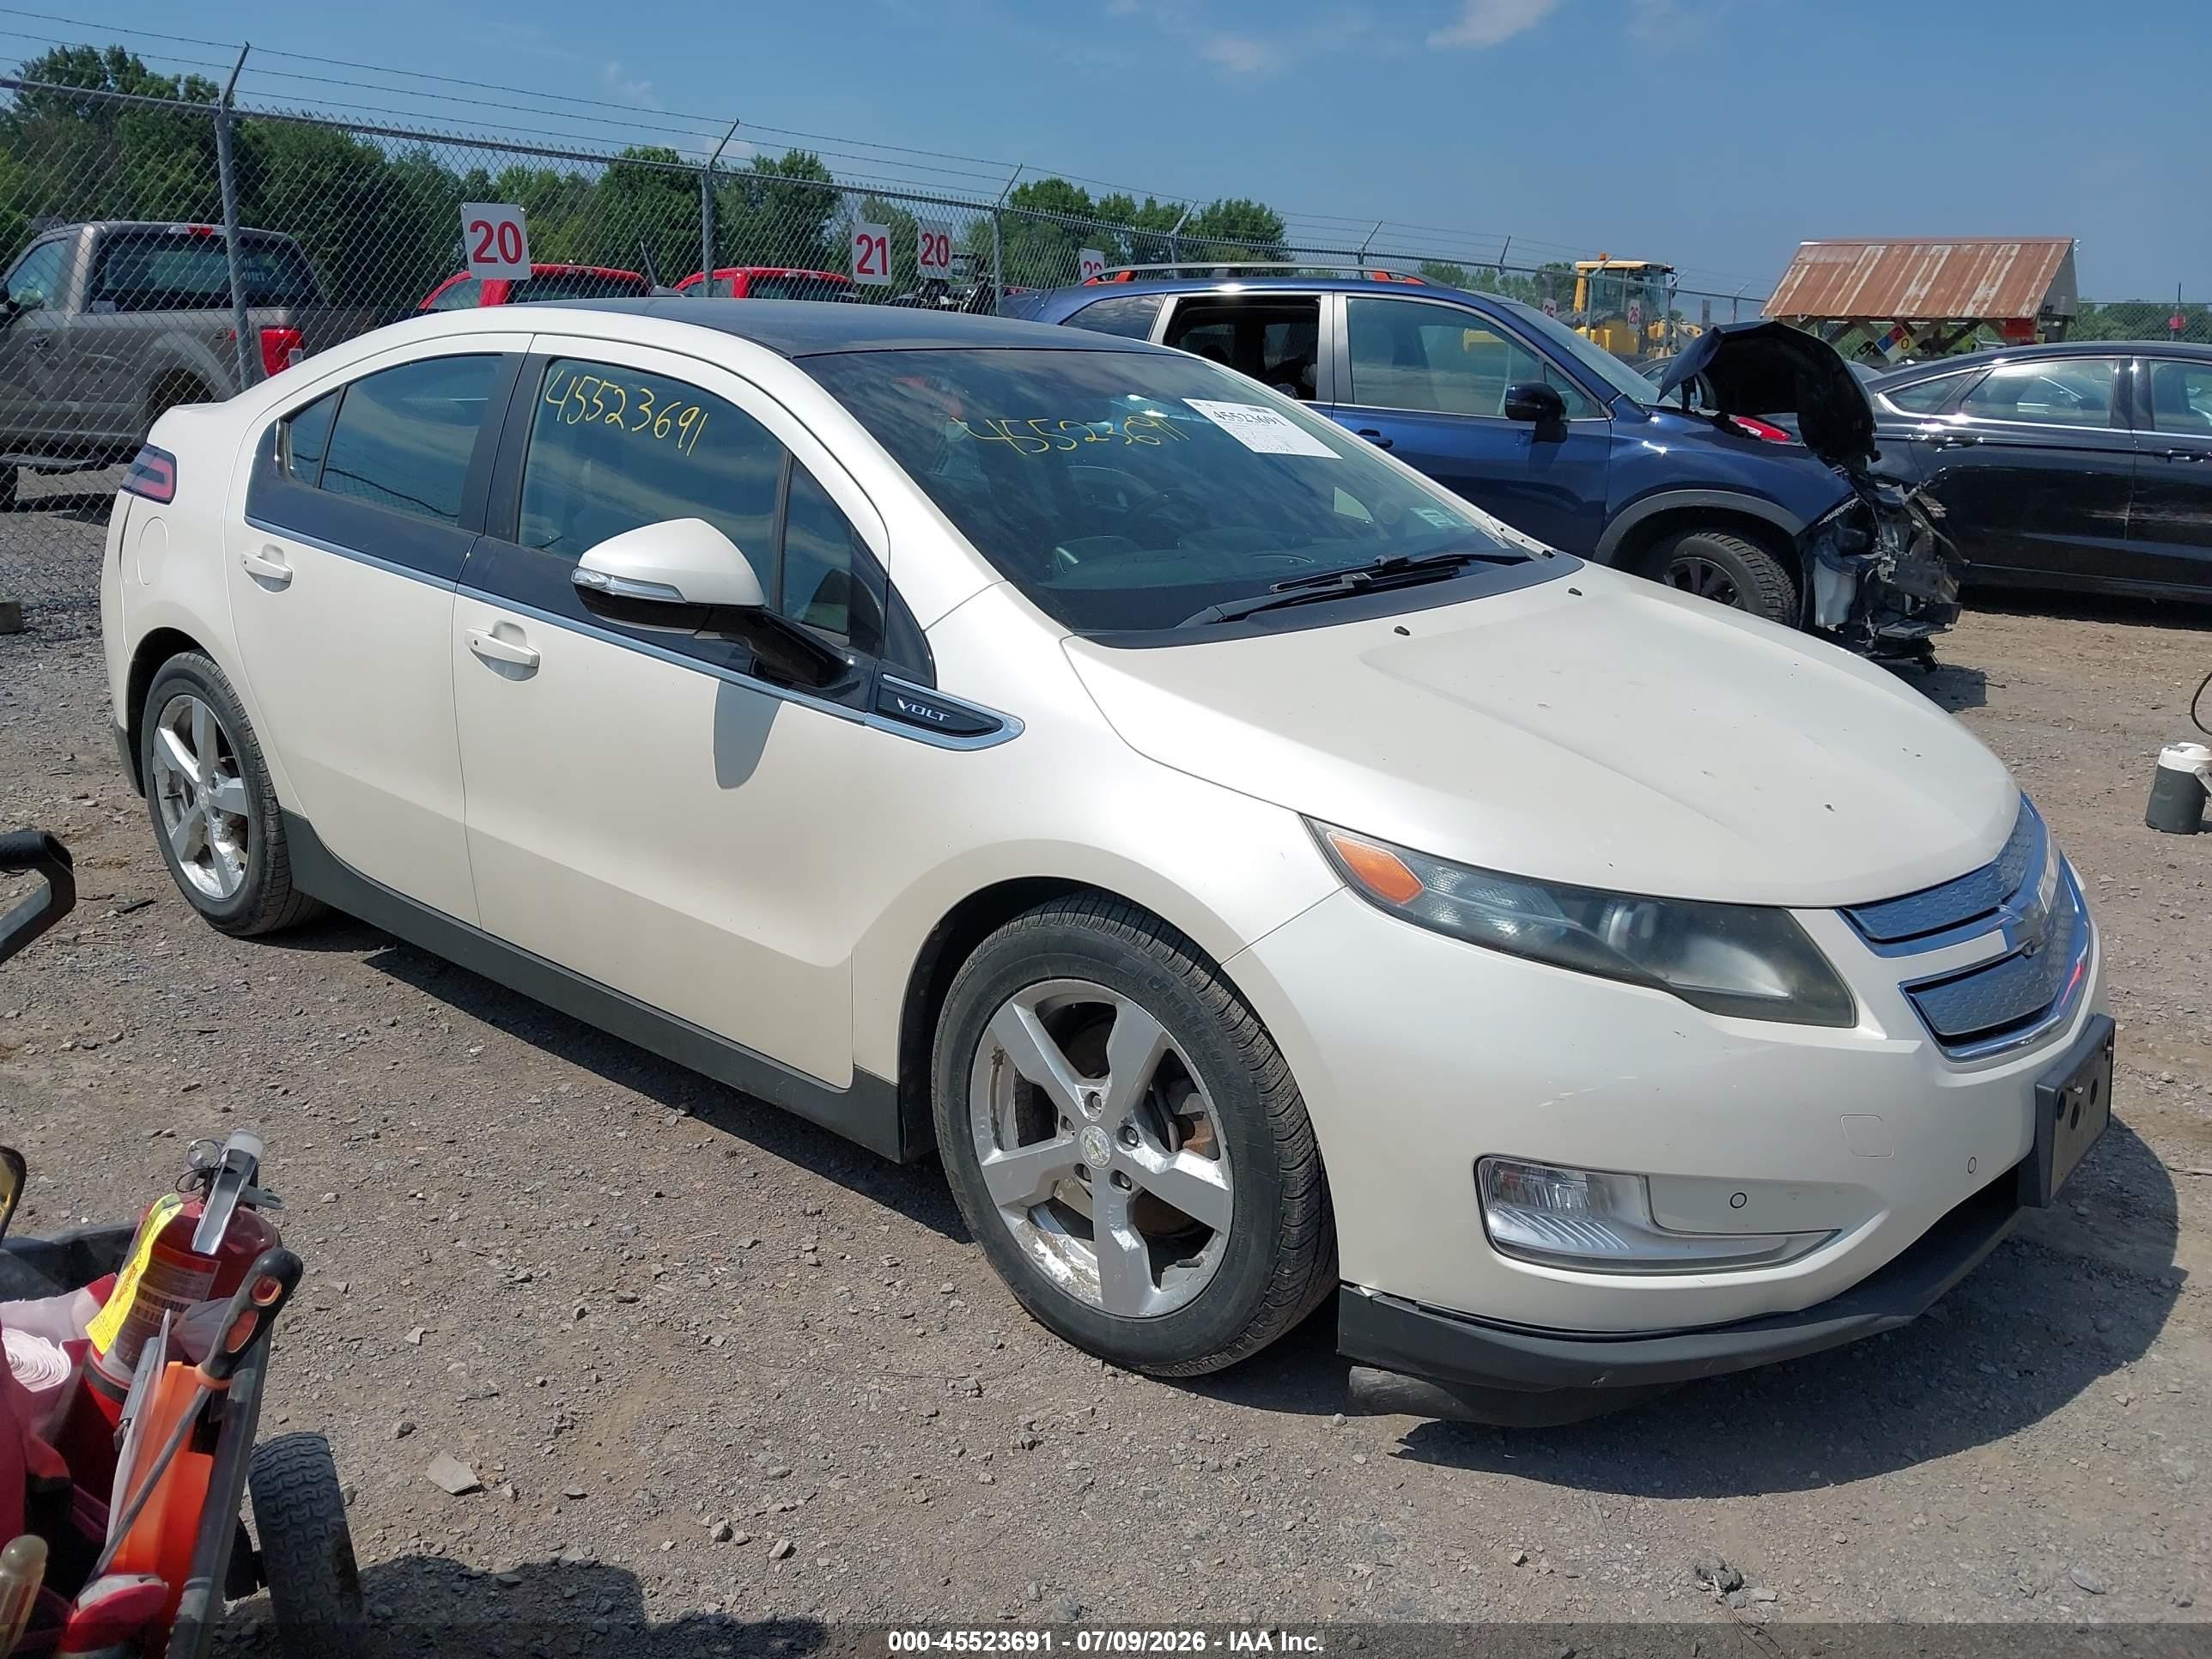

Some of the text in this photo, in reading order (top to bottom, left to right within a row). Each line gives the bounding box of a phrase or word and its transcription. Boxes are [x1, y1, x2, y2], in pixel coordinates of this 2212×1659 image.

[470, 219, 522, 264] 20
[855, 234, 889, 276] 21
[920, 233, 950, 268] 20
[545, 370, 708, 457] 45523691
[896, 696, 951, 721] VOLT
